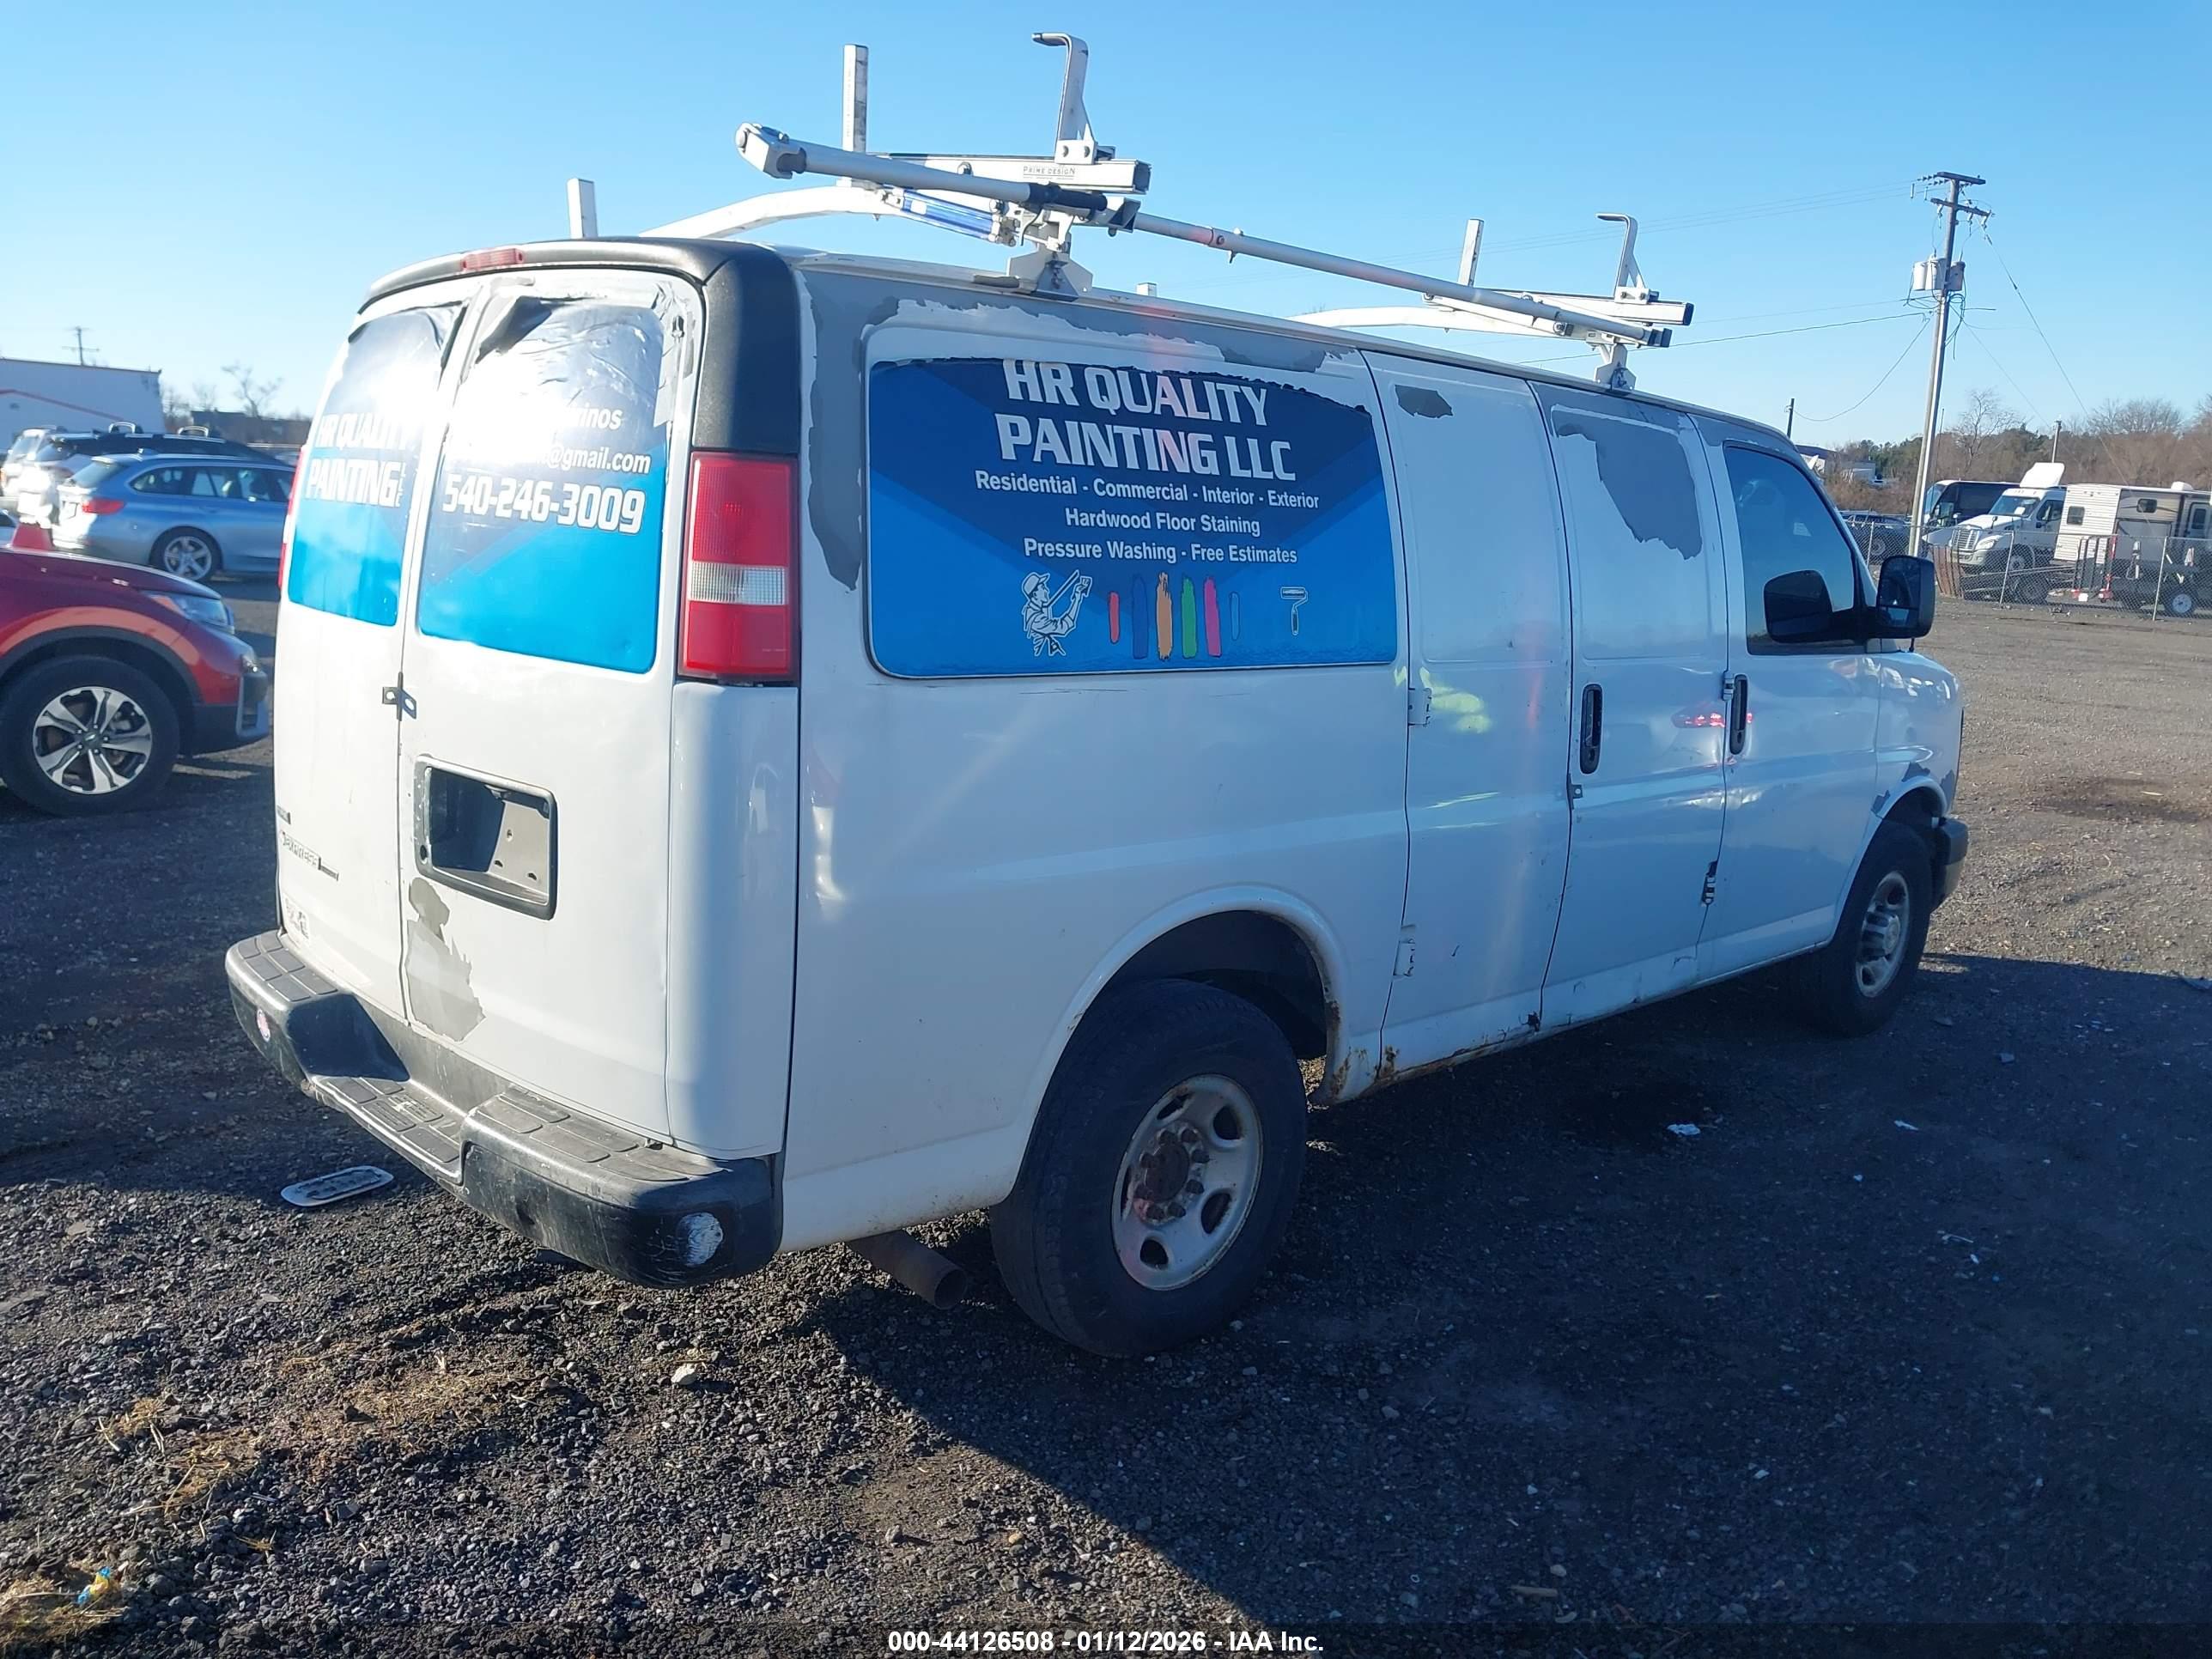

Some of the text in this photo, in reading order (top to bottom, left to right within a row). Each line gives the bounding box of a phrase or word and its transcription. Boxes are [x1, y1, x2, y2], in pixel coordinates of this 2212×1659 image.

[1002, 358, 1267, 426] HR QUALITY
[994, 412, 1297, 481] PAINTING LLC
[305, 458, 401, 507] PAINTING
[442, 472, 646, 535] 540-246-3009
[975, 470, 1078, 495] Residential
[1093, 477, 1188, 501] Commercial
[1202, 485, 1255, 505] Interior
[1267, 489, 1319, 508] Exterior
[1065, 507, 1261, 538] Hardwood Floor Staining
[1024, 538, 1103, 558] Pressure
[1106, 540, 1176, 564] Washing
[1190, 543, 1224, 562] Free
[1229, 544, 1297, 563] Estimates
